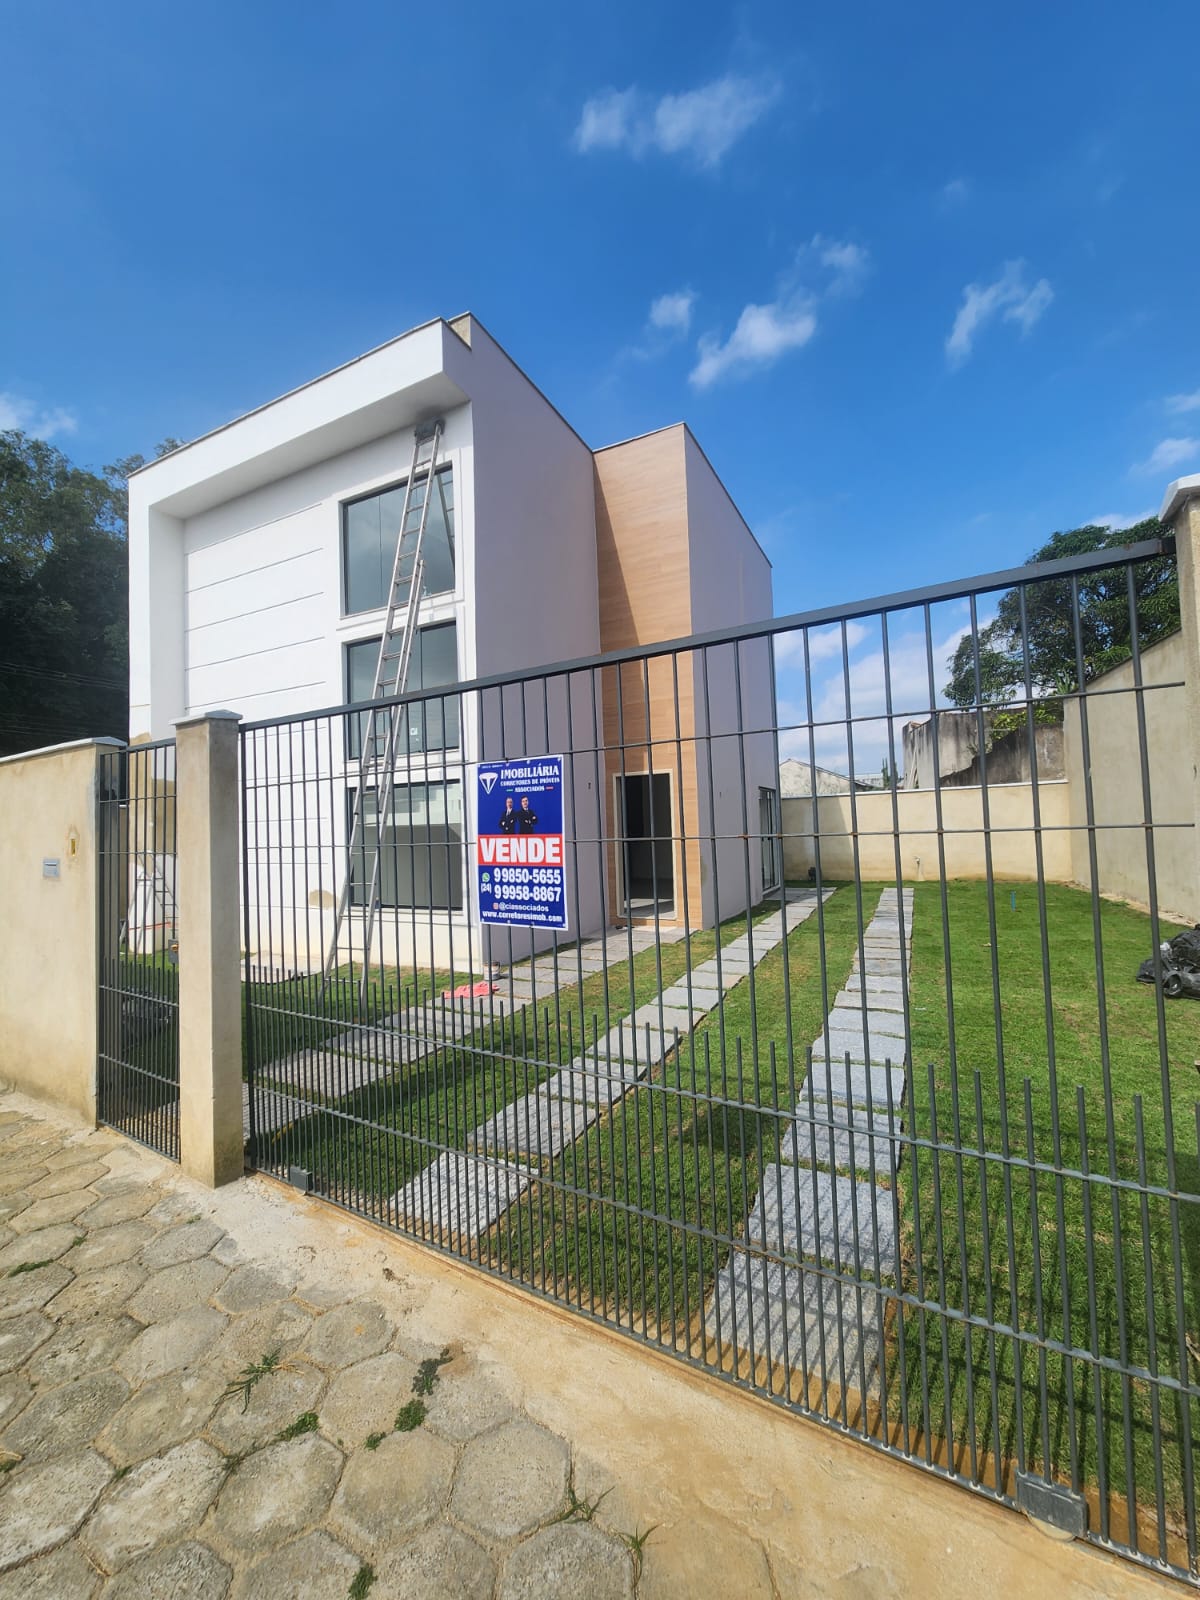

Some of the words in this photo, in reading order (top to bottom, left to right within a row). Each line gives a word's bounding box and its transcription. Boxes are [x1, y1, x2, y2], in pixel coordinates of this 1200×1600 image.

[500, 763, 560, 780] IMOBILIÁRIA
[500, 779, 531, 787] CORRETORES
[479, 837, 561, 864] VENDE
[482, 911, 562, 922] www.corretoresimob.com
